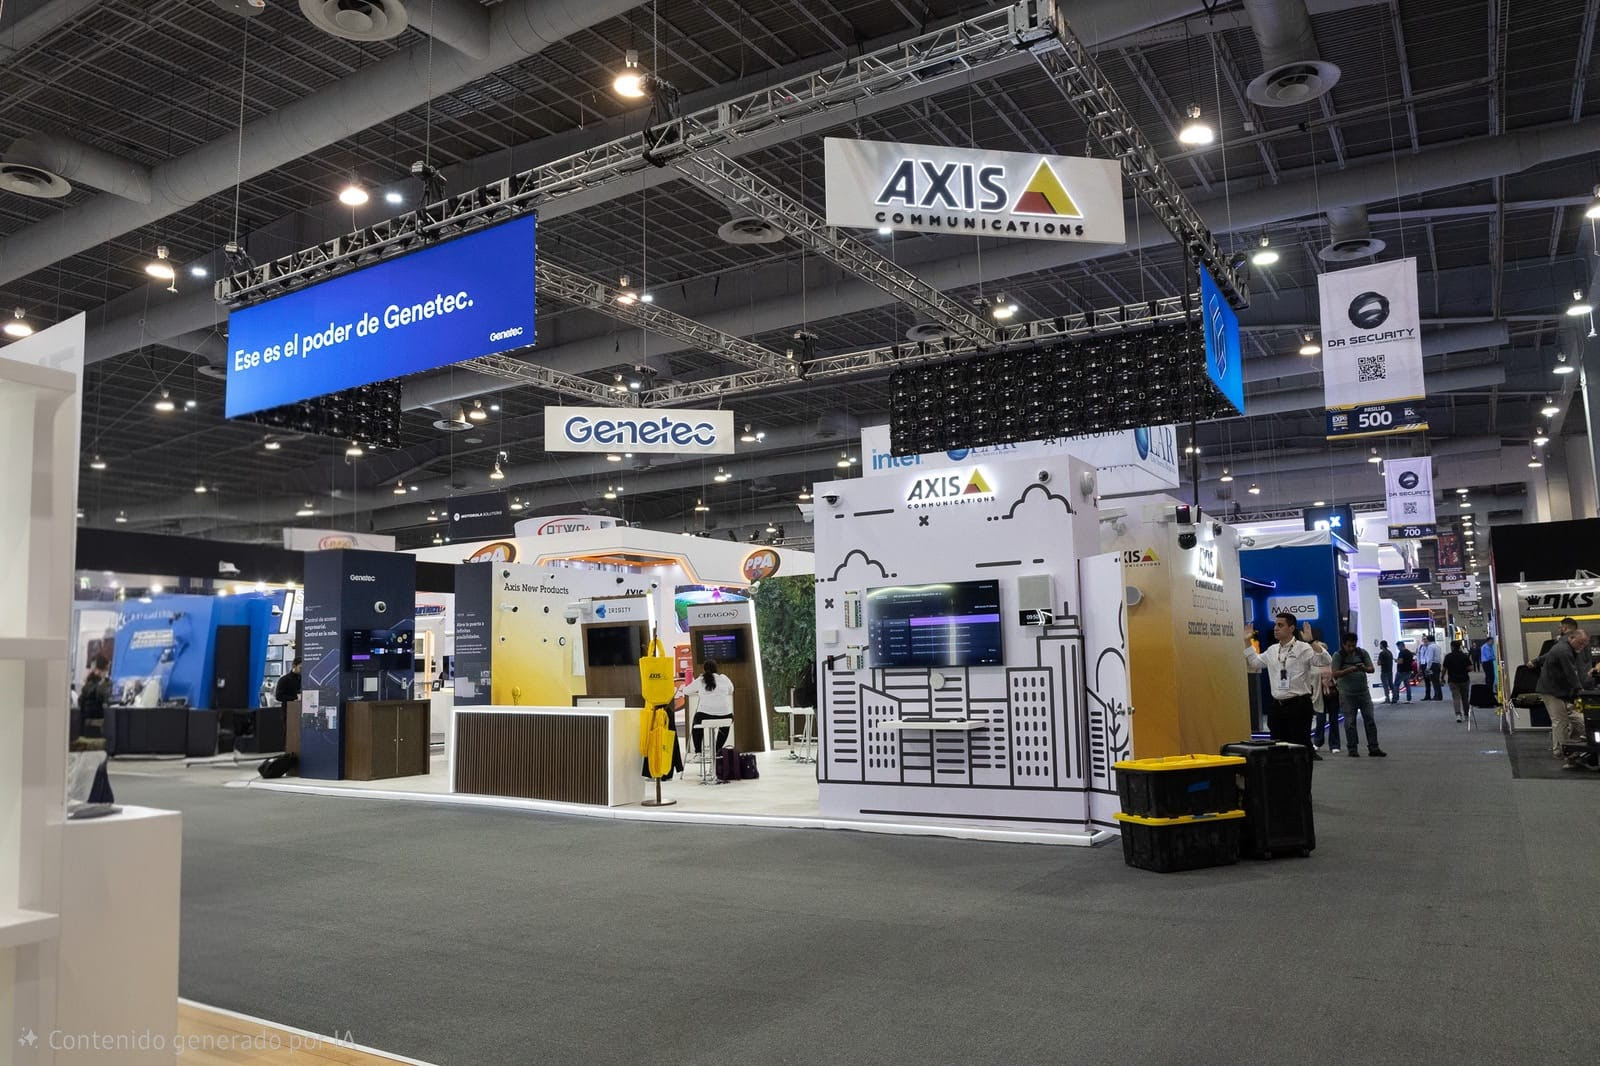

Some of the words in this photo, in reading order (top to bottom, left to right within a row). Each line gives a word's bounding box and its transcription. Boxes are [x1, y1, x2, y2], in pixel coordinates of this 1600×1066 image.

[876, 158, 1009, 211] AXIS
[875, 211, 1084, 237] COMMUNICATIONS
[234, 349, 260, 372] Ese
[263, 344, 281, 364] es
[284, 332, 298, 358] el
[302, 321, 353, 359] poder
[356, 312, 380, 337] de
[383, 290, 475, 330] Genetec.
[489, 326, 524, 342] Genetec
[1327, 339, 1346, 348] DR
[1349, 328, 1415, 345] SECURITY
[1358, 411, 1393, 428] 500
[564, 415, 716, 446] Genetec
[907, 475, 961, 501] AXIS
[907, 496, 996, 510] COMMUNICATIONS
[1403, 528, 1421, 537] 700
[745, 552, 773, 571] PPA
[349, 574, 376, 582] Genetec
[503, 582, 521, 592] Axis
[521, 584, 538, 593] New
[539, 585, 570, 595] Products
[1271, 604, 1316, 614] MAGOS
